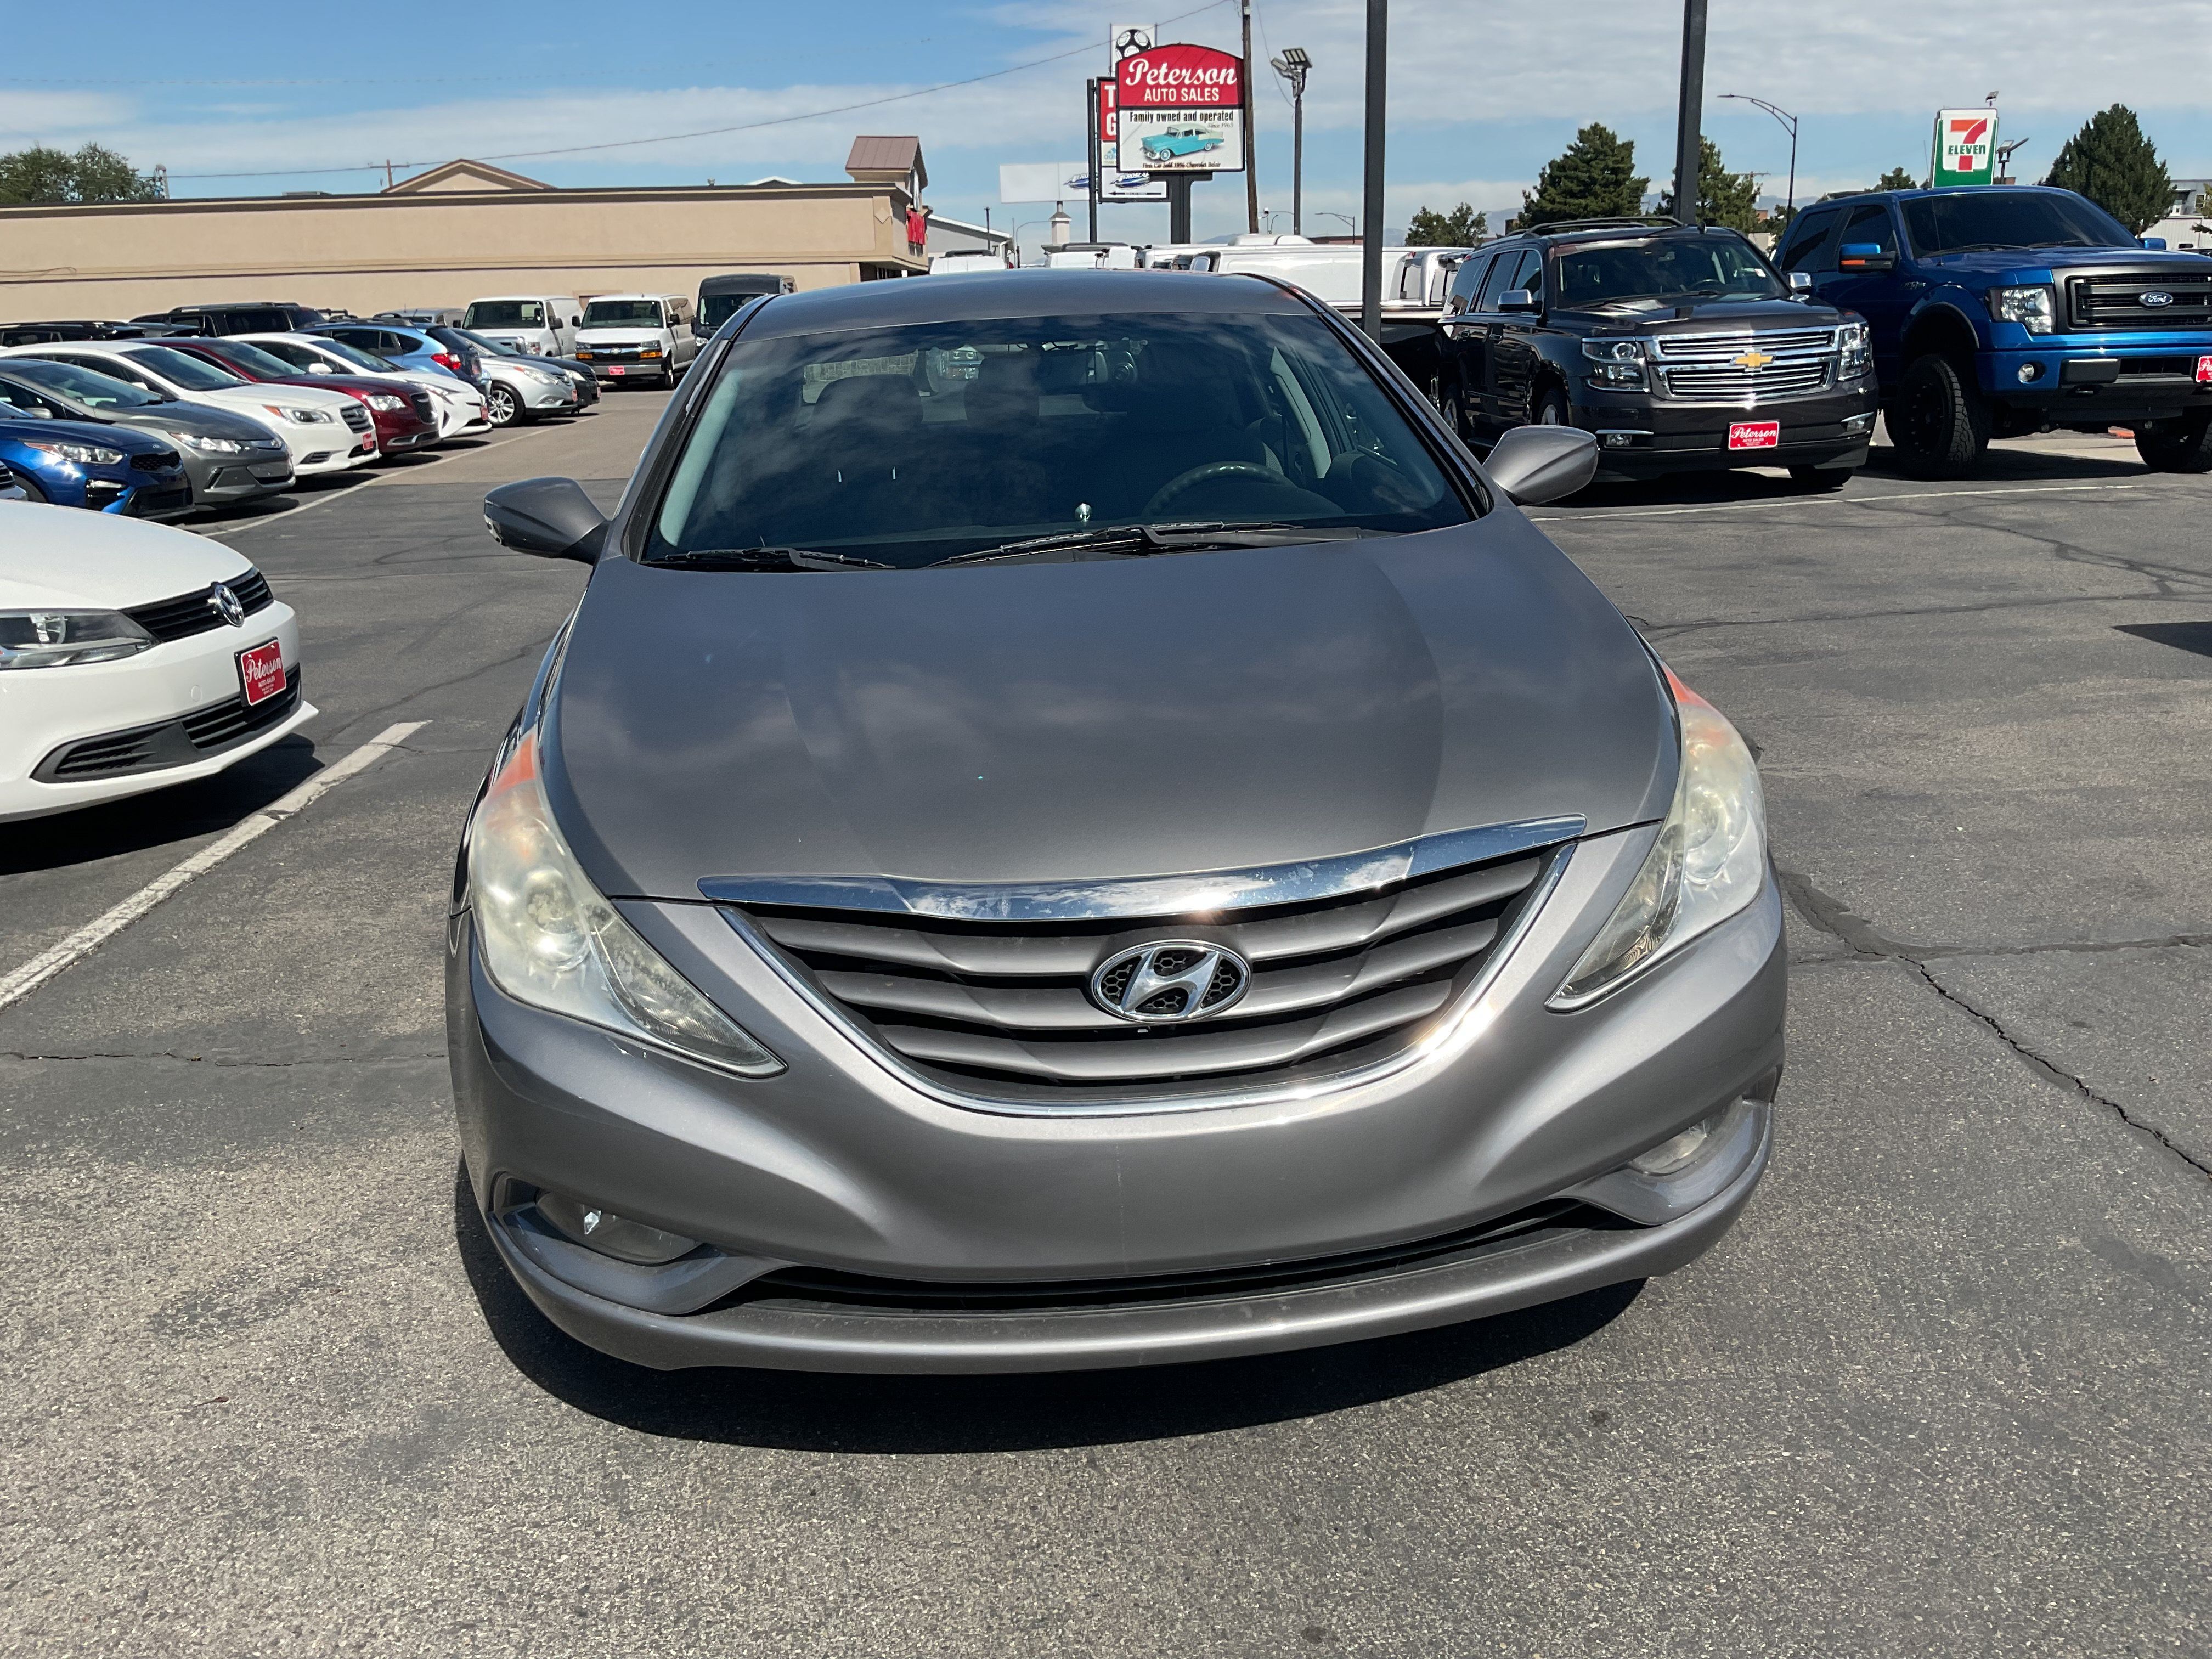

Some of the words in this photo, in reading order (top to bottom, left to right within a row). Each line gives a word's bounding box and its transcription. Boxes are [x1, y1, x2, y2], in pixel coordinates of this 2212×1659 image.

[1125, 59, 1237, 86] Peterson
[1144, 88, 1177, 101] AUTO
[1181, 88, 1219, 101] SALES
[1130, 111, 1154, 123] Family
[1156, 111, 1180, 121] owned
[1183, 111, 1197, 121] and
[1200, 111, 1233, 123] operated
[1950, 118, 1988, 171] 7
[2148, 294, 2166, 302] Ford
[1731, 427, 1776, 438] Peterson
[246, 657, 282, 683] Peterson
